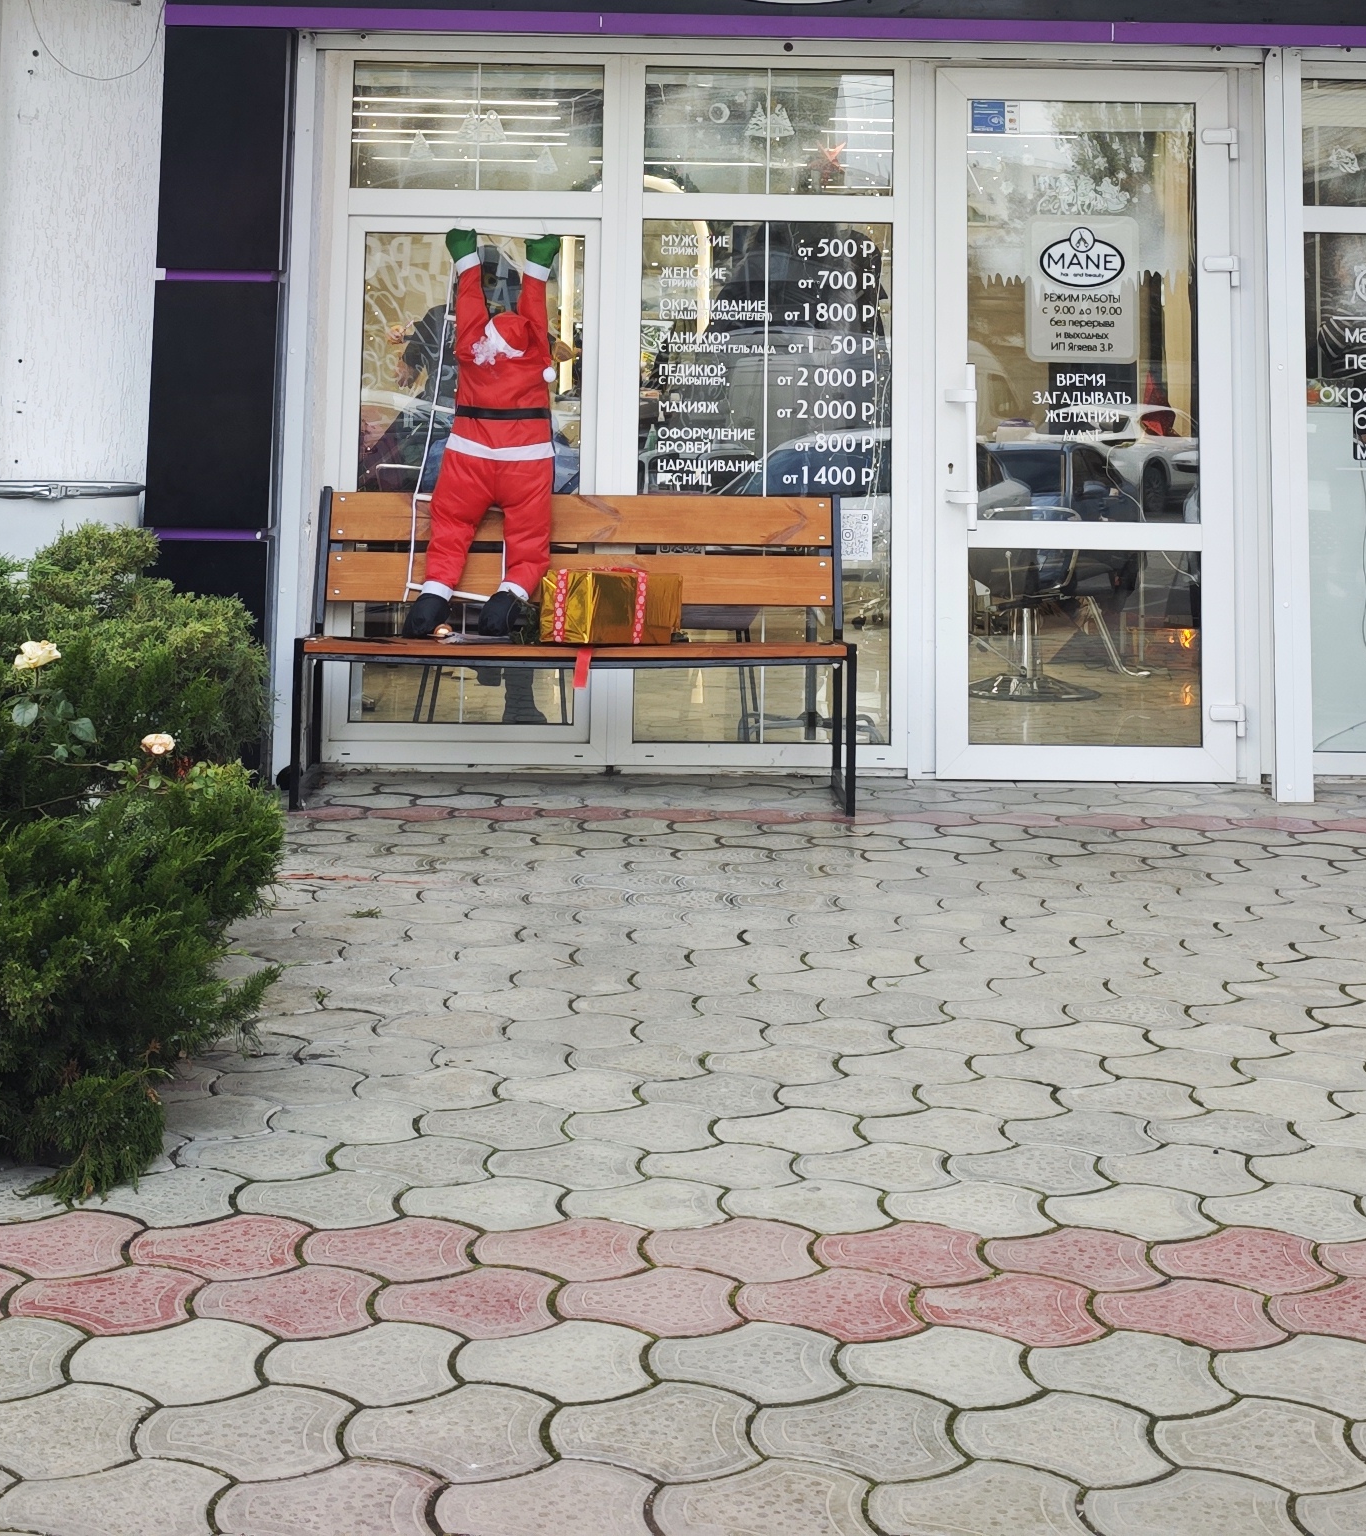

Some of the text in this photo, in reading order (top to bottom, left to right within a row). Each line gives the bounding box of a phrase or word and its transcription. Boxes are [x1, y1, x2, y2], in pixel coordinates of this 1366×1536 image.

[798, 247, 814, 257] от
[816, 239, 857, 257] 500
[1047, 252, 1118, 271] MANE
[798, 279, 814, 289] от
[817, 270, 857, 289] 700
[1044, 293, 1121, 303] РЕЖИМ РАБОТЫ
[1054, 306, 1076, 315] 9.00
[1095, 306, 1122, 315] 19.00
[1049, 317, 1115, 329] без перерыва
[659, 331, 731, 344] МАНИКЮР
[1063, 332, 1109, 340] выходных
[1050, 342, 1066, 351] ИП
[658, 364, 727, 377] ПЕДИКЮР
[1056, 373, 1106, 386] ВРЕМЯ
[1032, 391, 1132, 406] ЗАГАДЫВАТЬ
[658, 400, 719, 414] МАКИЯЖ
[1044, 409, 1120, 423] ЖЕЛАНИЯ
[657, 427, 756, 441] ОФОРМЛЕНИЕ
[657, 438, 712, 453] БРОВЕЙ
[795, 442, 810, 452] от
[815, 433, 856, 452] 800
[657, 459, 763, 472] НАРАЩИВАНИЕ
